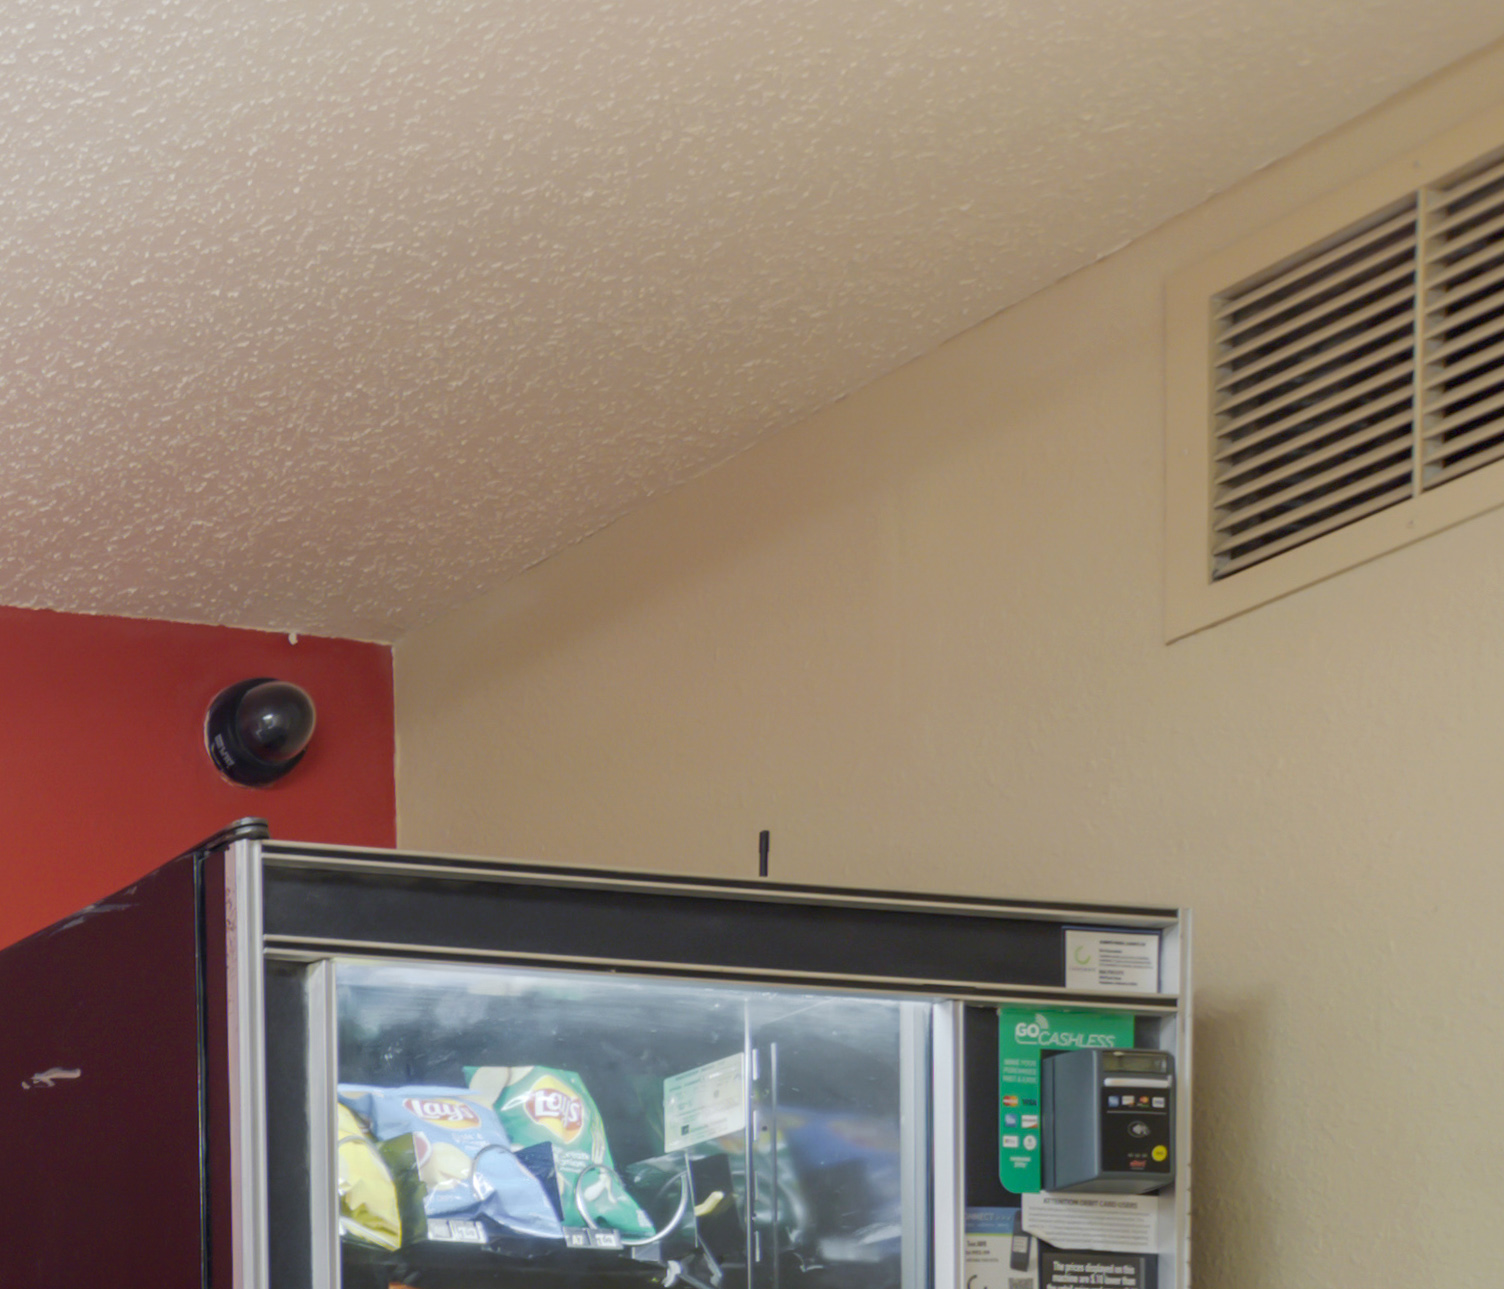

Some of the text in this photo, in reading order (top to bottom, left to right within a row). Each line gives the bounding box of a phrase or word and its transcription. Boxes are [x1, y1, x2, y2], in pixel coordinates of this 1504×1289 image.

[1015, 1023, 1116, 1048] GO CASHLESS
[410, 1099, 477, 1123] Lay's
